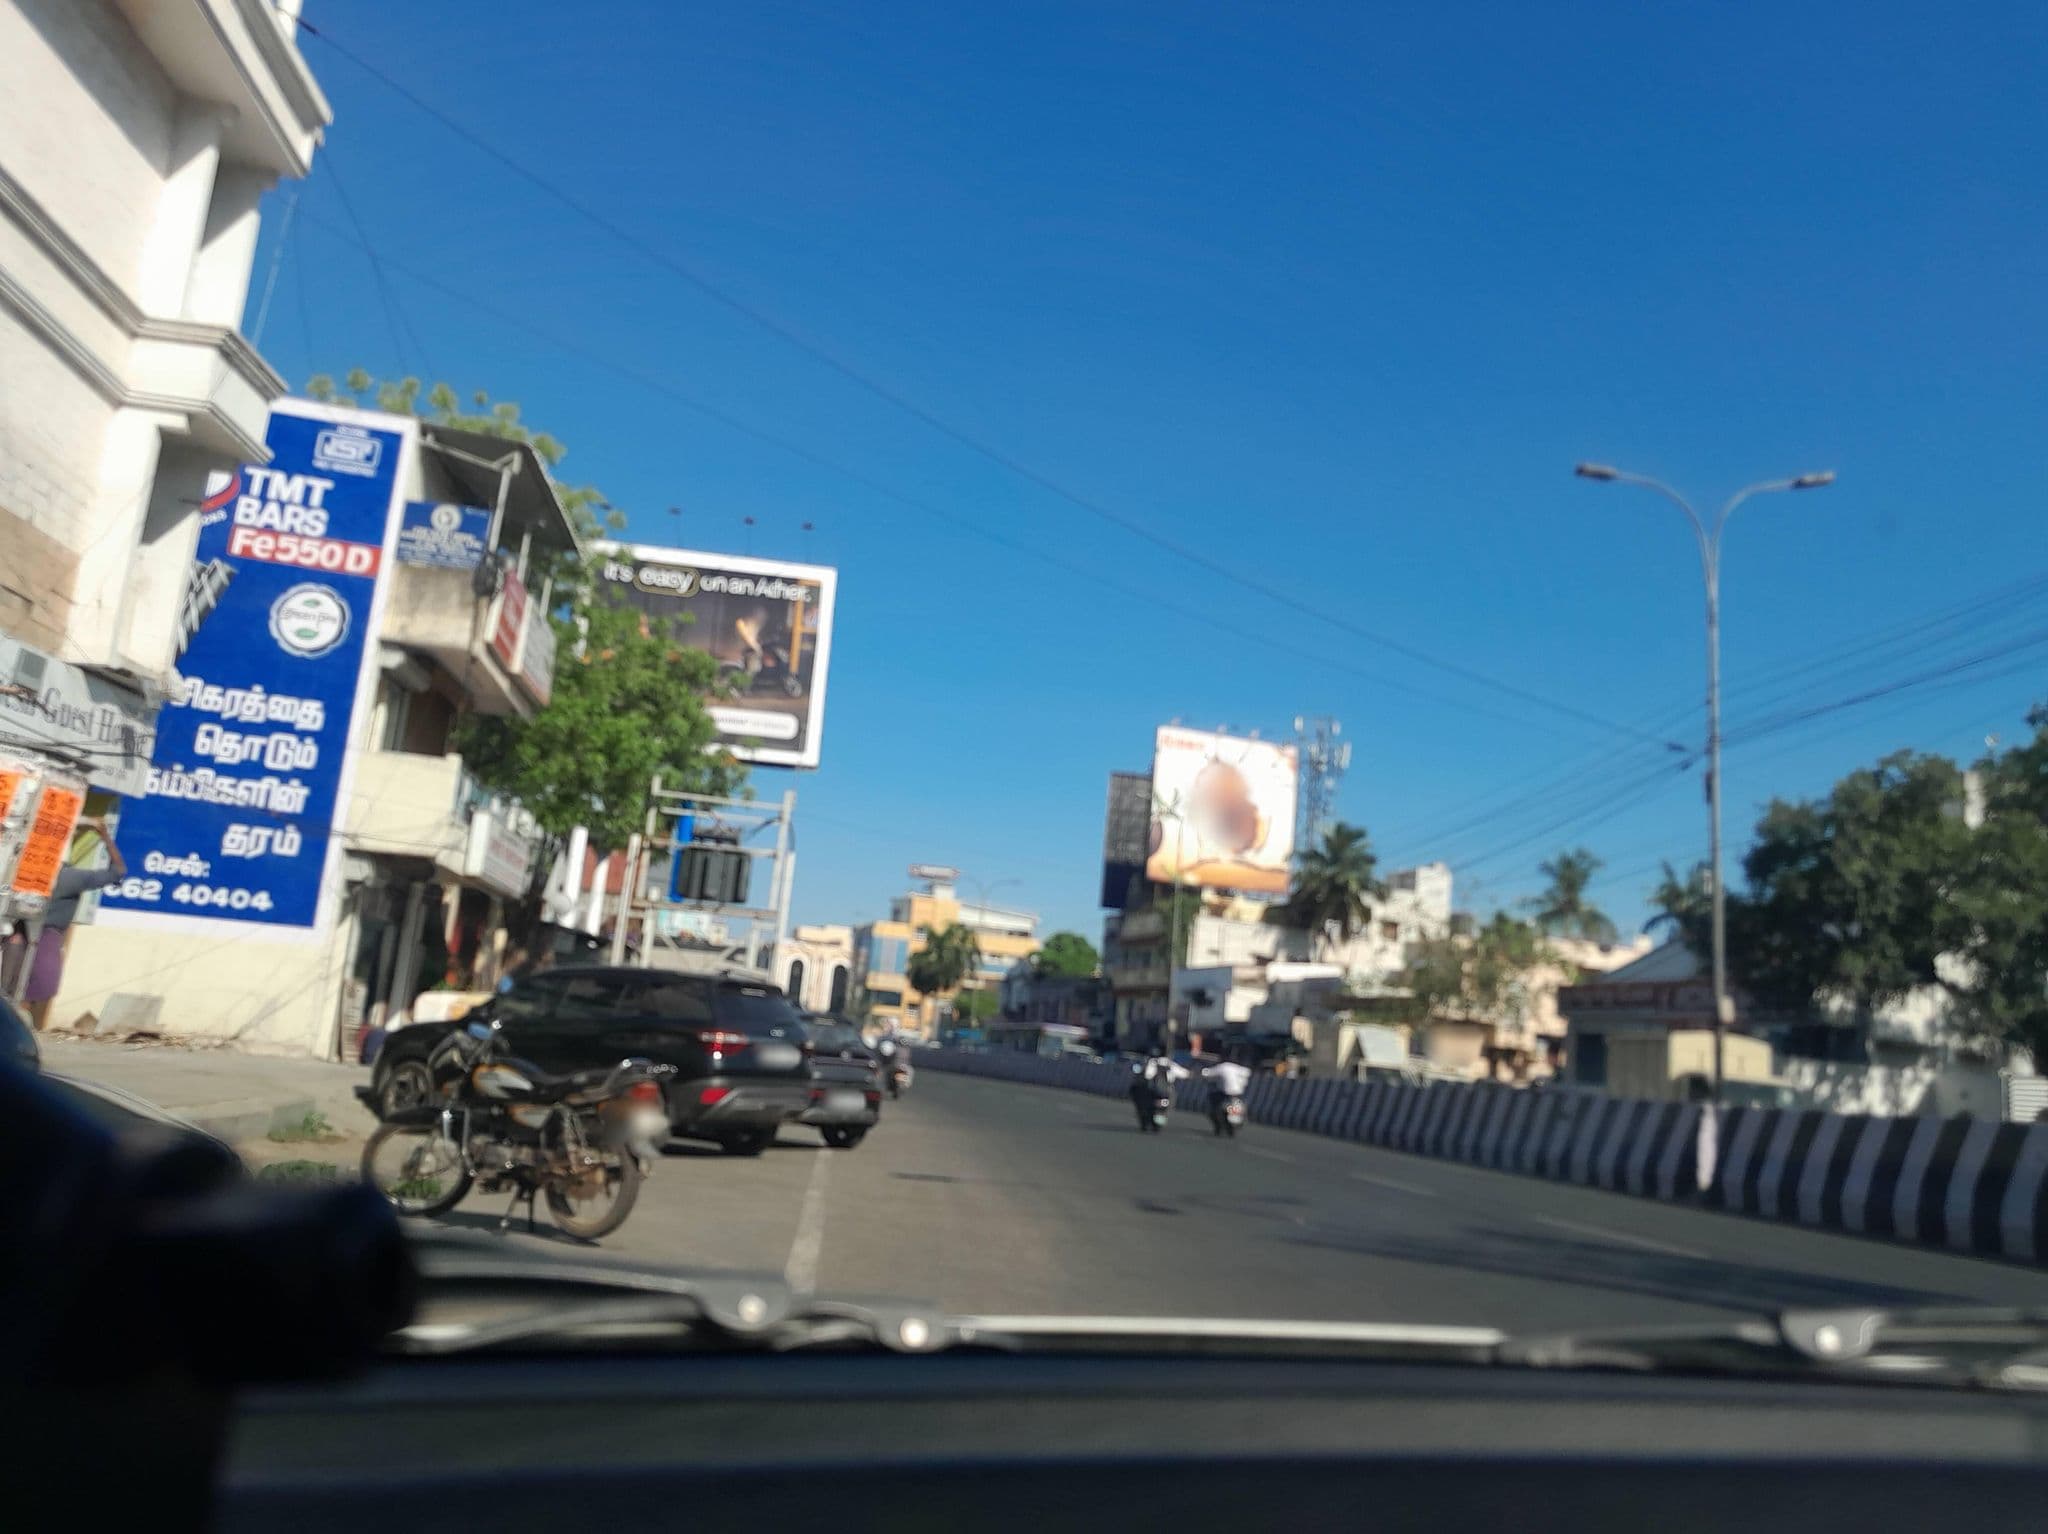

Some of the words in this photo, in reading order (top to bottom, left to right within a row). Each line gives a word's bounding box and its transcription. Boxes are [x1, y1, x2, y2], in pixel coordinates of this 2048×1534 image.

[245, 466, 336, 507] TMT
[233, 494, 330, 538] BARS
[639, 567, 693, 594] easy
[194, 722, 319, 772] தொடும்
[221, 822, 303, 859] தரம்
[171, 882, 275, 913] 40404
